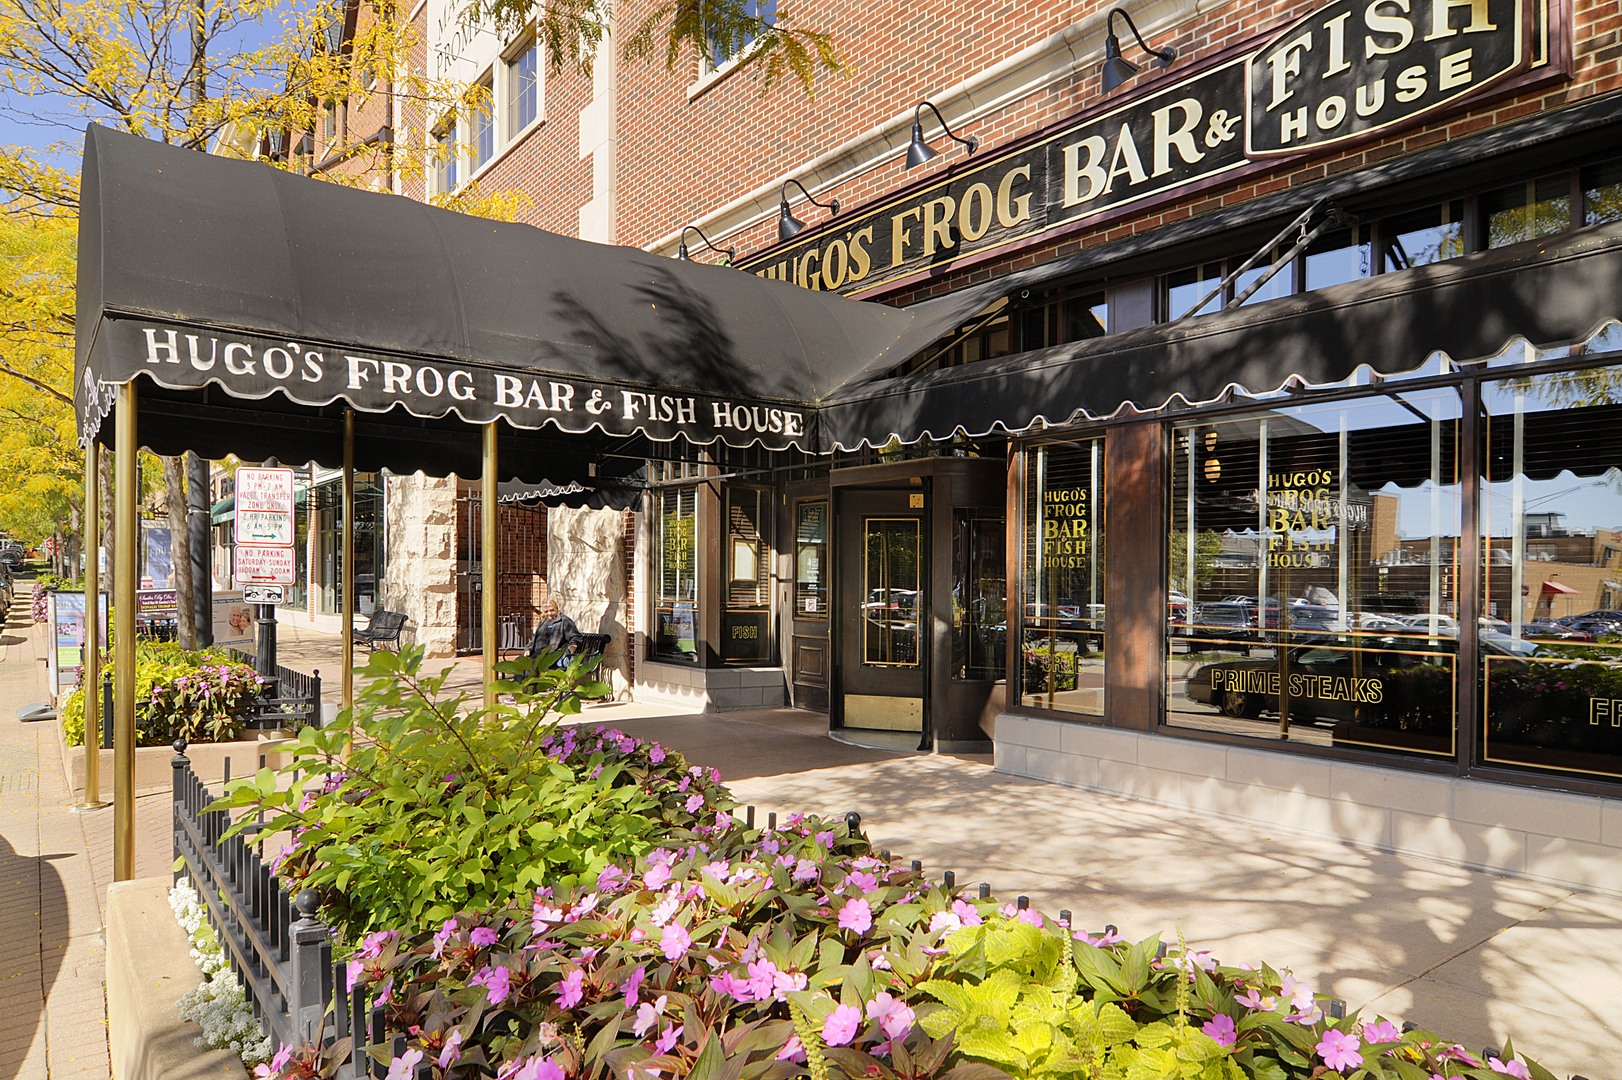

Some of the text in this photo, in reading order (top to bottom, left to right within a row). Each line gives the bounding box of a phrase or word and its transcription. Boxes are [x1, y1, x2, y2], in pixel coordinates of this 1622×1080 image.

[1266, 0, 1497, 112] FISH
[1280, 48, 1473, 144] HOUSE
[890, 163, 1034, 268] FROG
[1061, 98, 1206, 209] BAR
[1204, 109, 1242, 148] &
[142, 328, 804, 437] HUGO'S FROG BAR & FISH HOUSE
[246, 473, 283, 481] NO PARKING
[1268, 468, 1332, 488] HUGO'S
[247, 482, 251, 490] 5
[275, 483, 284, 491] AM
[240, 491, 291, 501] VALET TRANSFER
[1043, 487, 1087, 502] HUGO'S
[1267, 487, 1330, 507] FROG
[248, 501, 281, 510] ZONE ONLY
[1043, 503, 1087, 518] FROG
[243, 513, 287, 522] 2 HR PARKING
[804, 507, 823, 523] 127
[1268, 507, 1332, 533] BAR
[1043, 519, 1088, 539] BAR
[669, 538, 688, 551] BAR
[1043, 540, 1086, 555] FISH
[1268, 534, 1331, 551] FISH
[245, 549, 285, 558] NO PARKING
[669, 551, 687, 560] FISH
[1267, 552, 1331, 569] HOUSE
[1043, 556, 1086, 569] HOUSE
[732, 625, 758, 639] FISH
[1211, 668, 1383, 704] PRIME STEAKS
